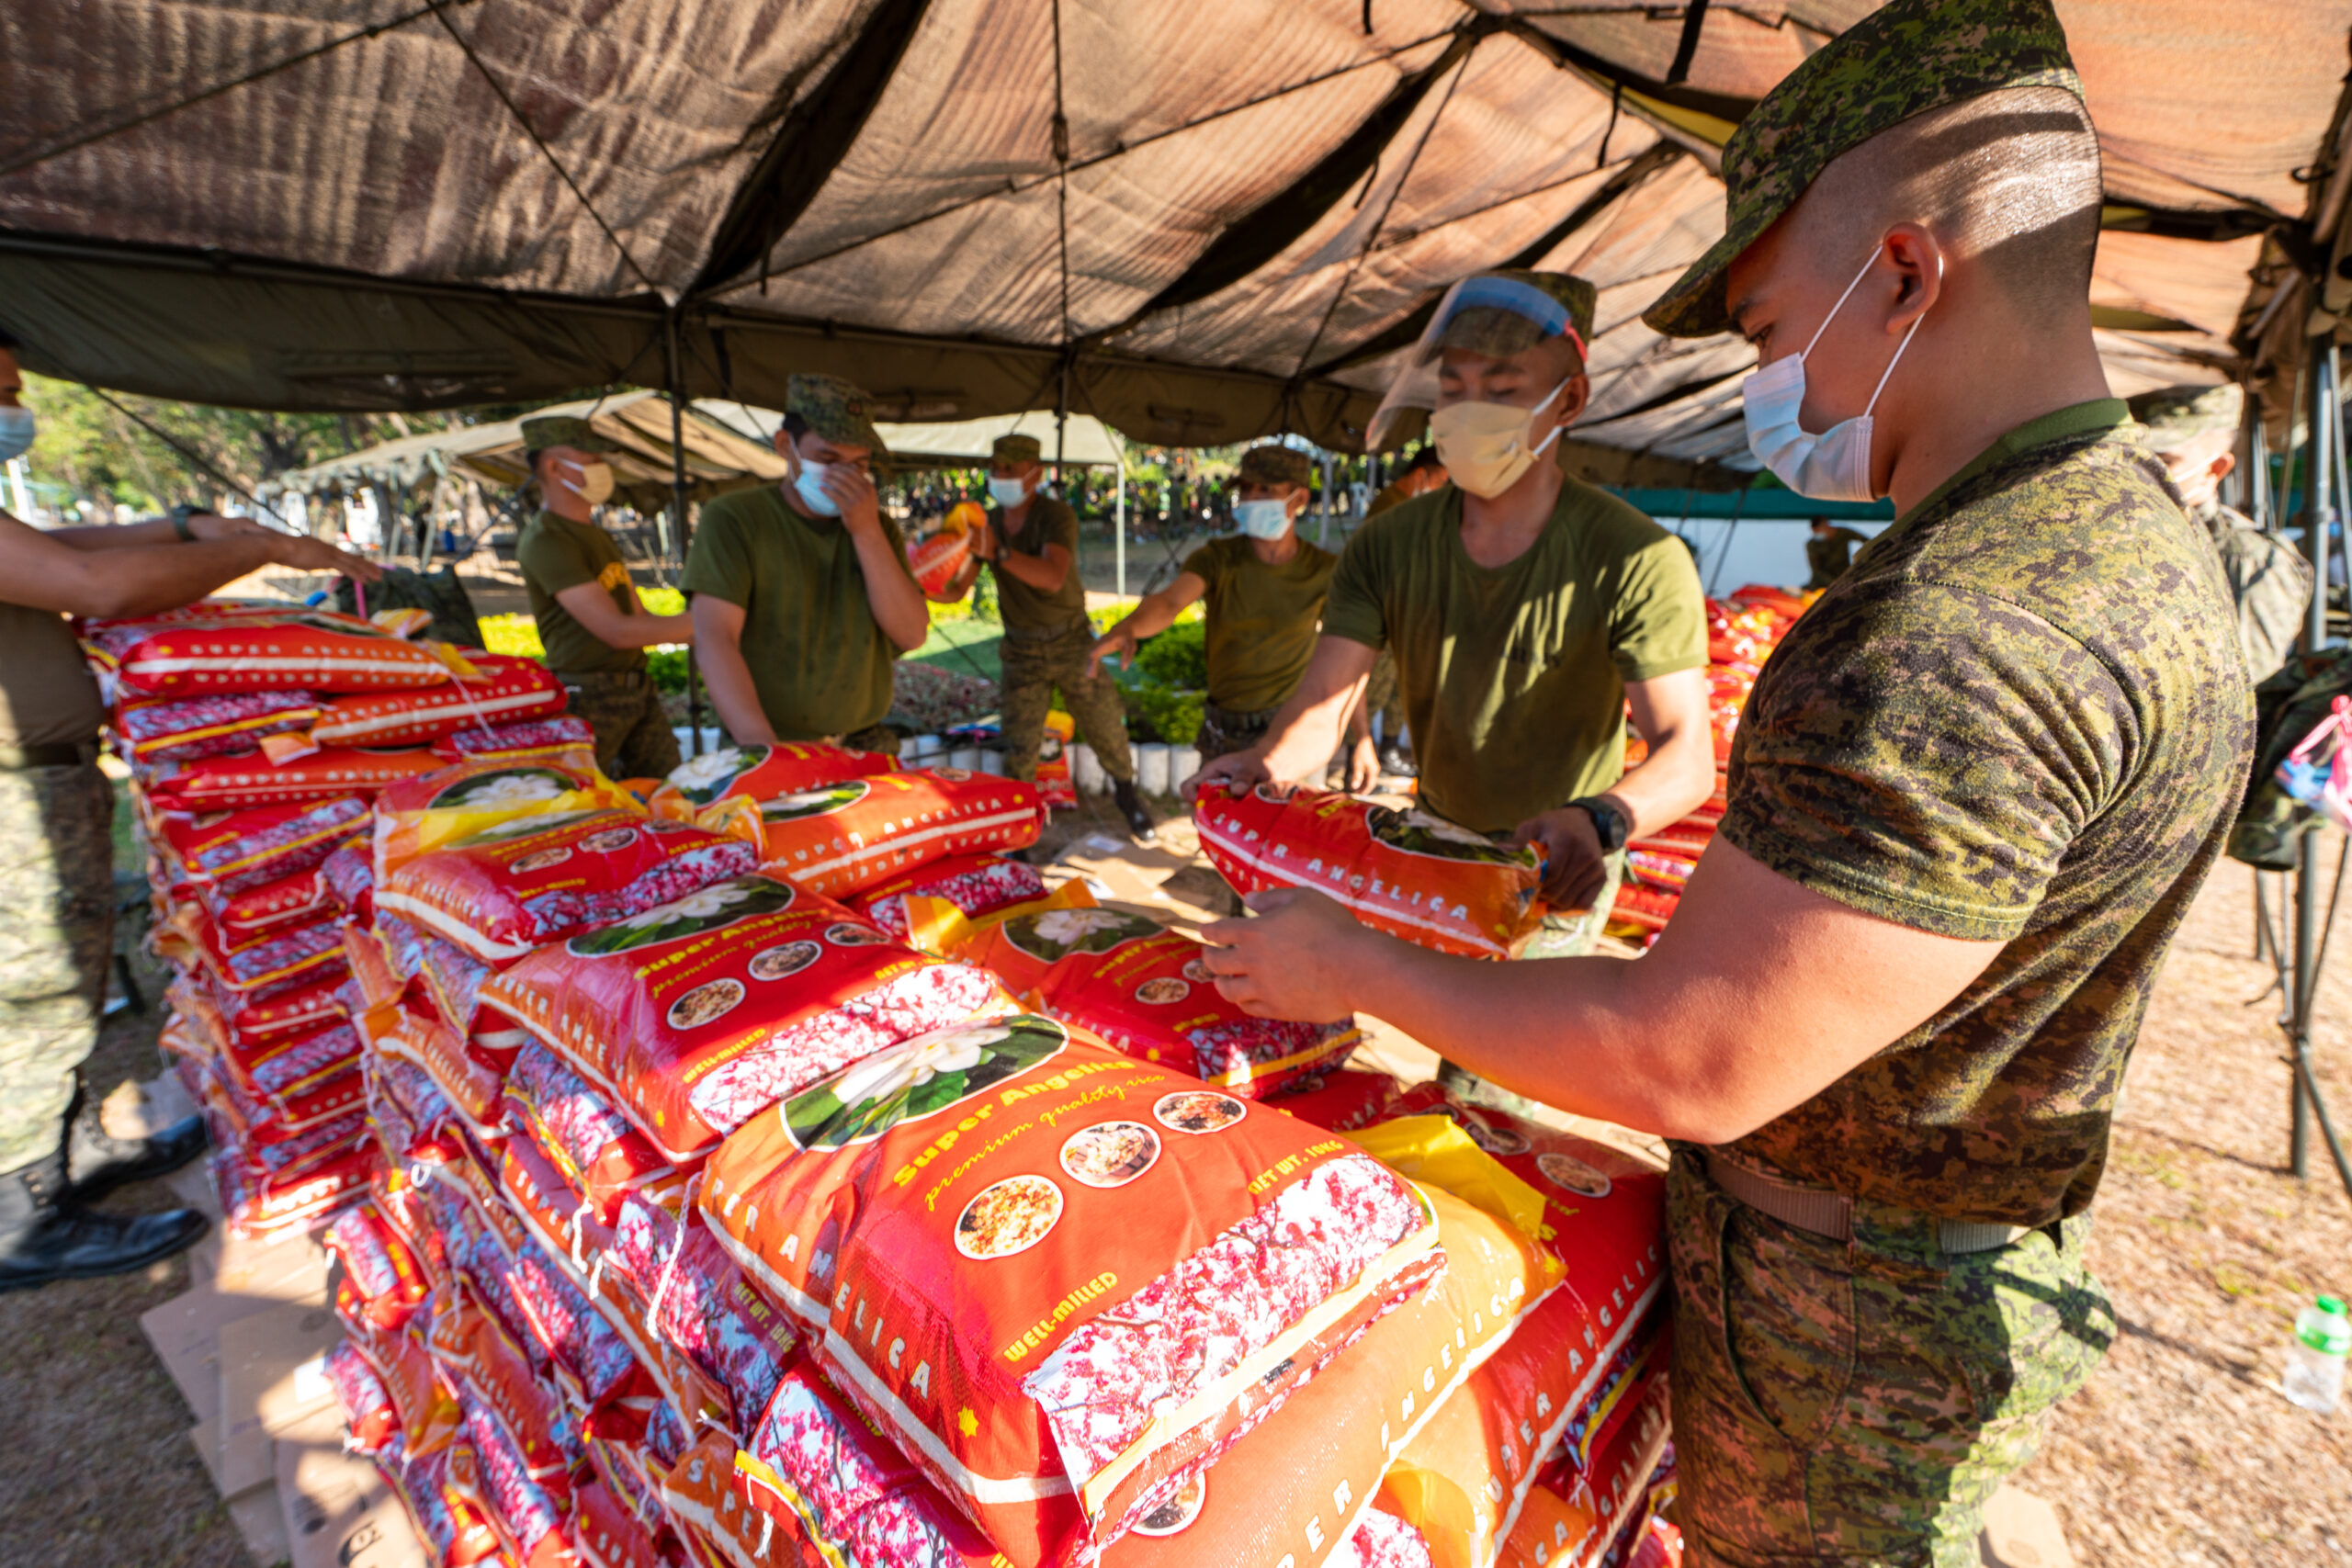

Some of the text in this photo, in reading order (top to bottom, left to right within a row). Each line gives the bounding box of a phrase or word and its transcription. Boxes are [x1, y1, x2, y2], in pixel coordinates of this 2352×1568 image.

[1306, 856, 1470, 921] ANGELICA
[893, 1060, 1136, 1189] Super Angelica
[924, 1122, 1034, 1212] premium
[1039, 1083, 1126, 1127] quality
[1305, 1139, 1345, 1159] 10KG
[1002, 1271, 1118, 1362] WELL-MILLED
